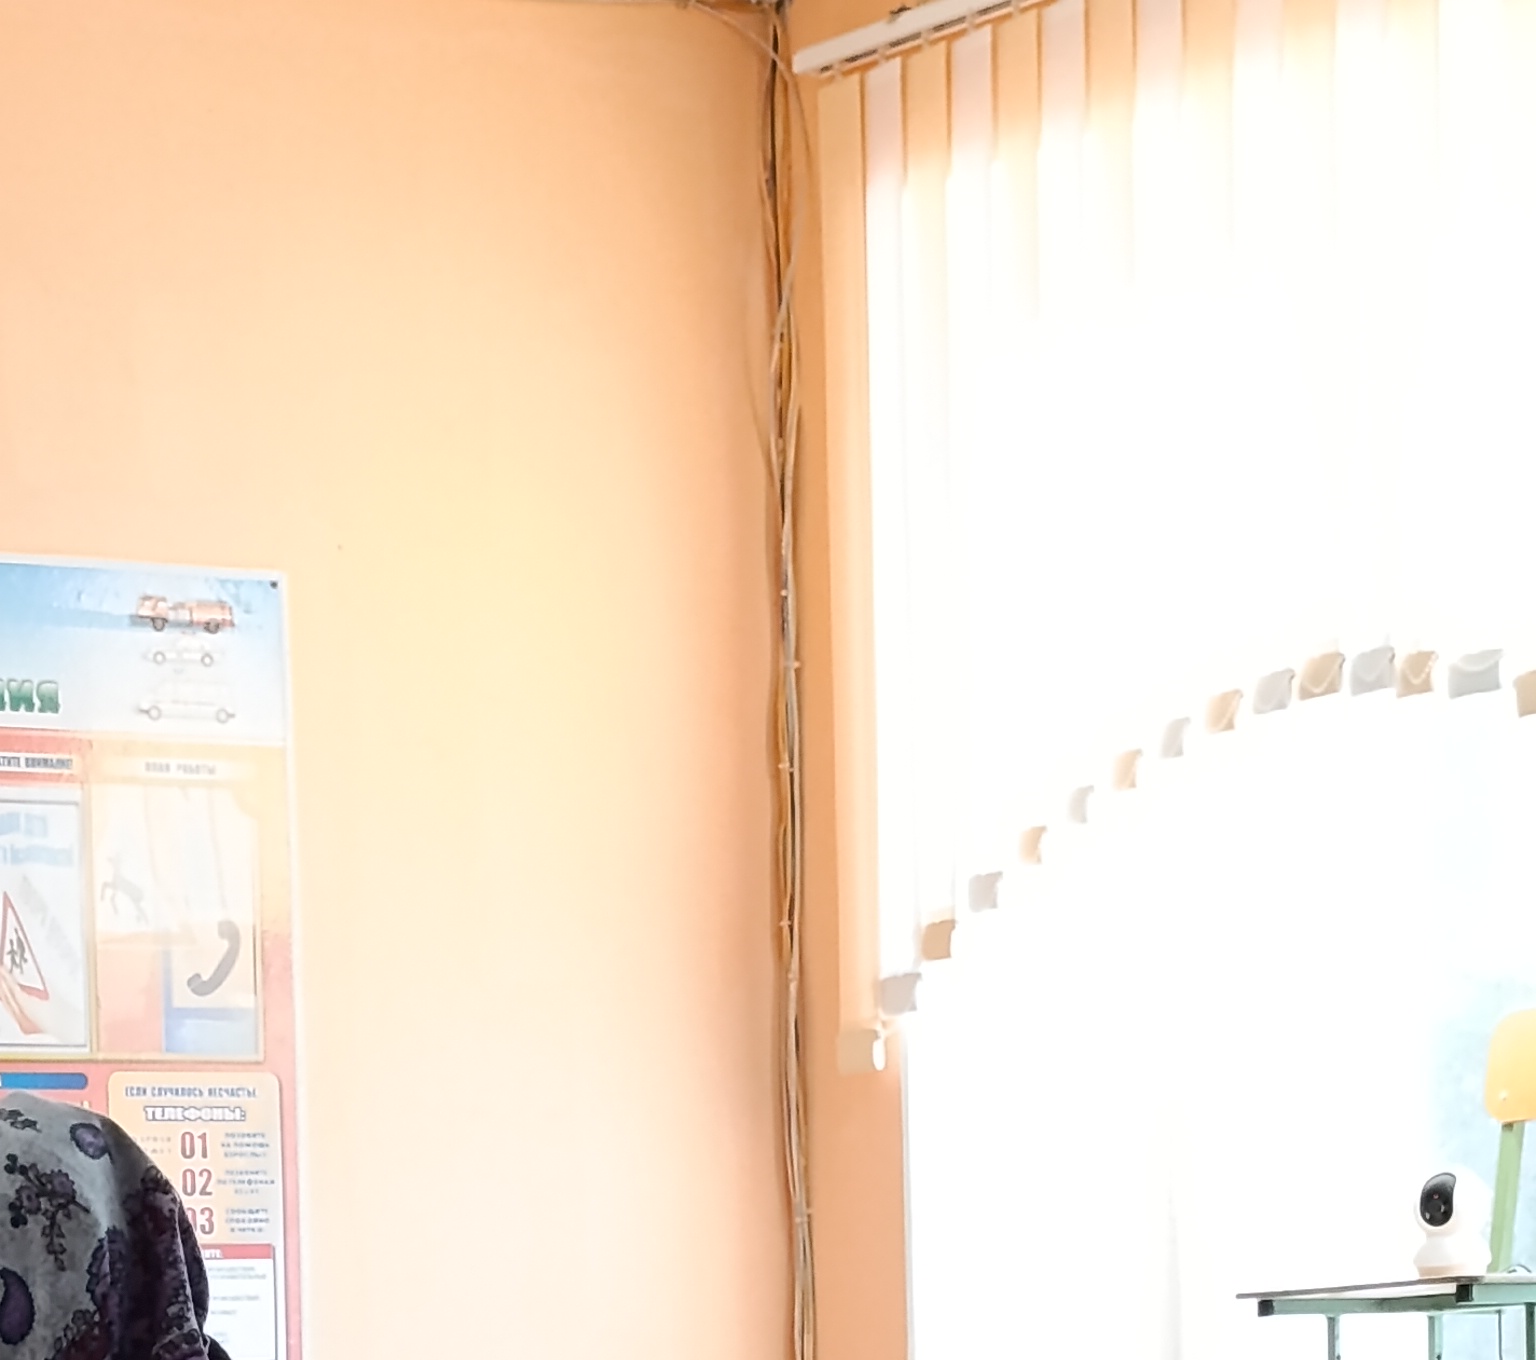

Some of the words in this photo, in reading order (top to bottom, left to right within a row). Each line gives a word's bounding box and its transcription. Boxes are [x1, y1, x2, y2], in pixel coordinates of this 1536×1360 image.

[125, 1086, 146, 1097] ЕСЛИ
[144, 1106, 246, 1121] ТЕЛЕФОНЫ:
[181, 1132, 208, 1159] 01
[182, 1168, 213, 1196] 02
